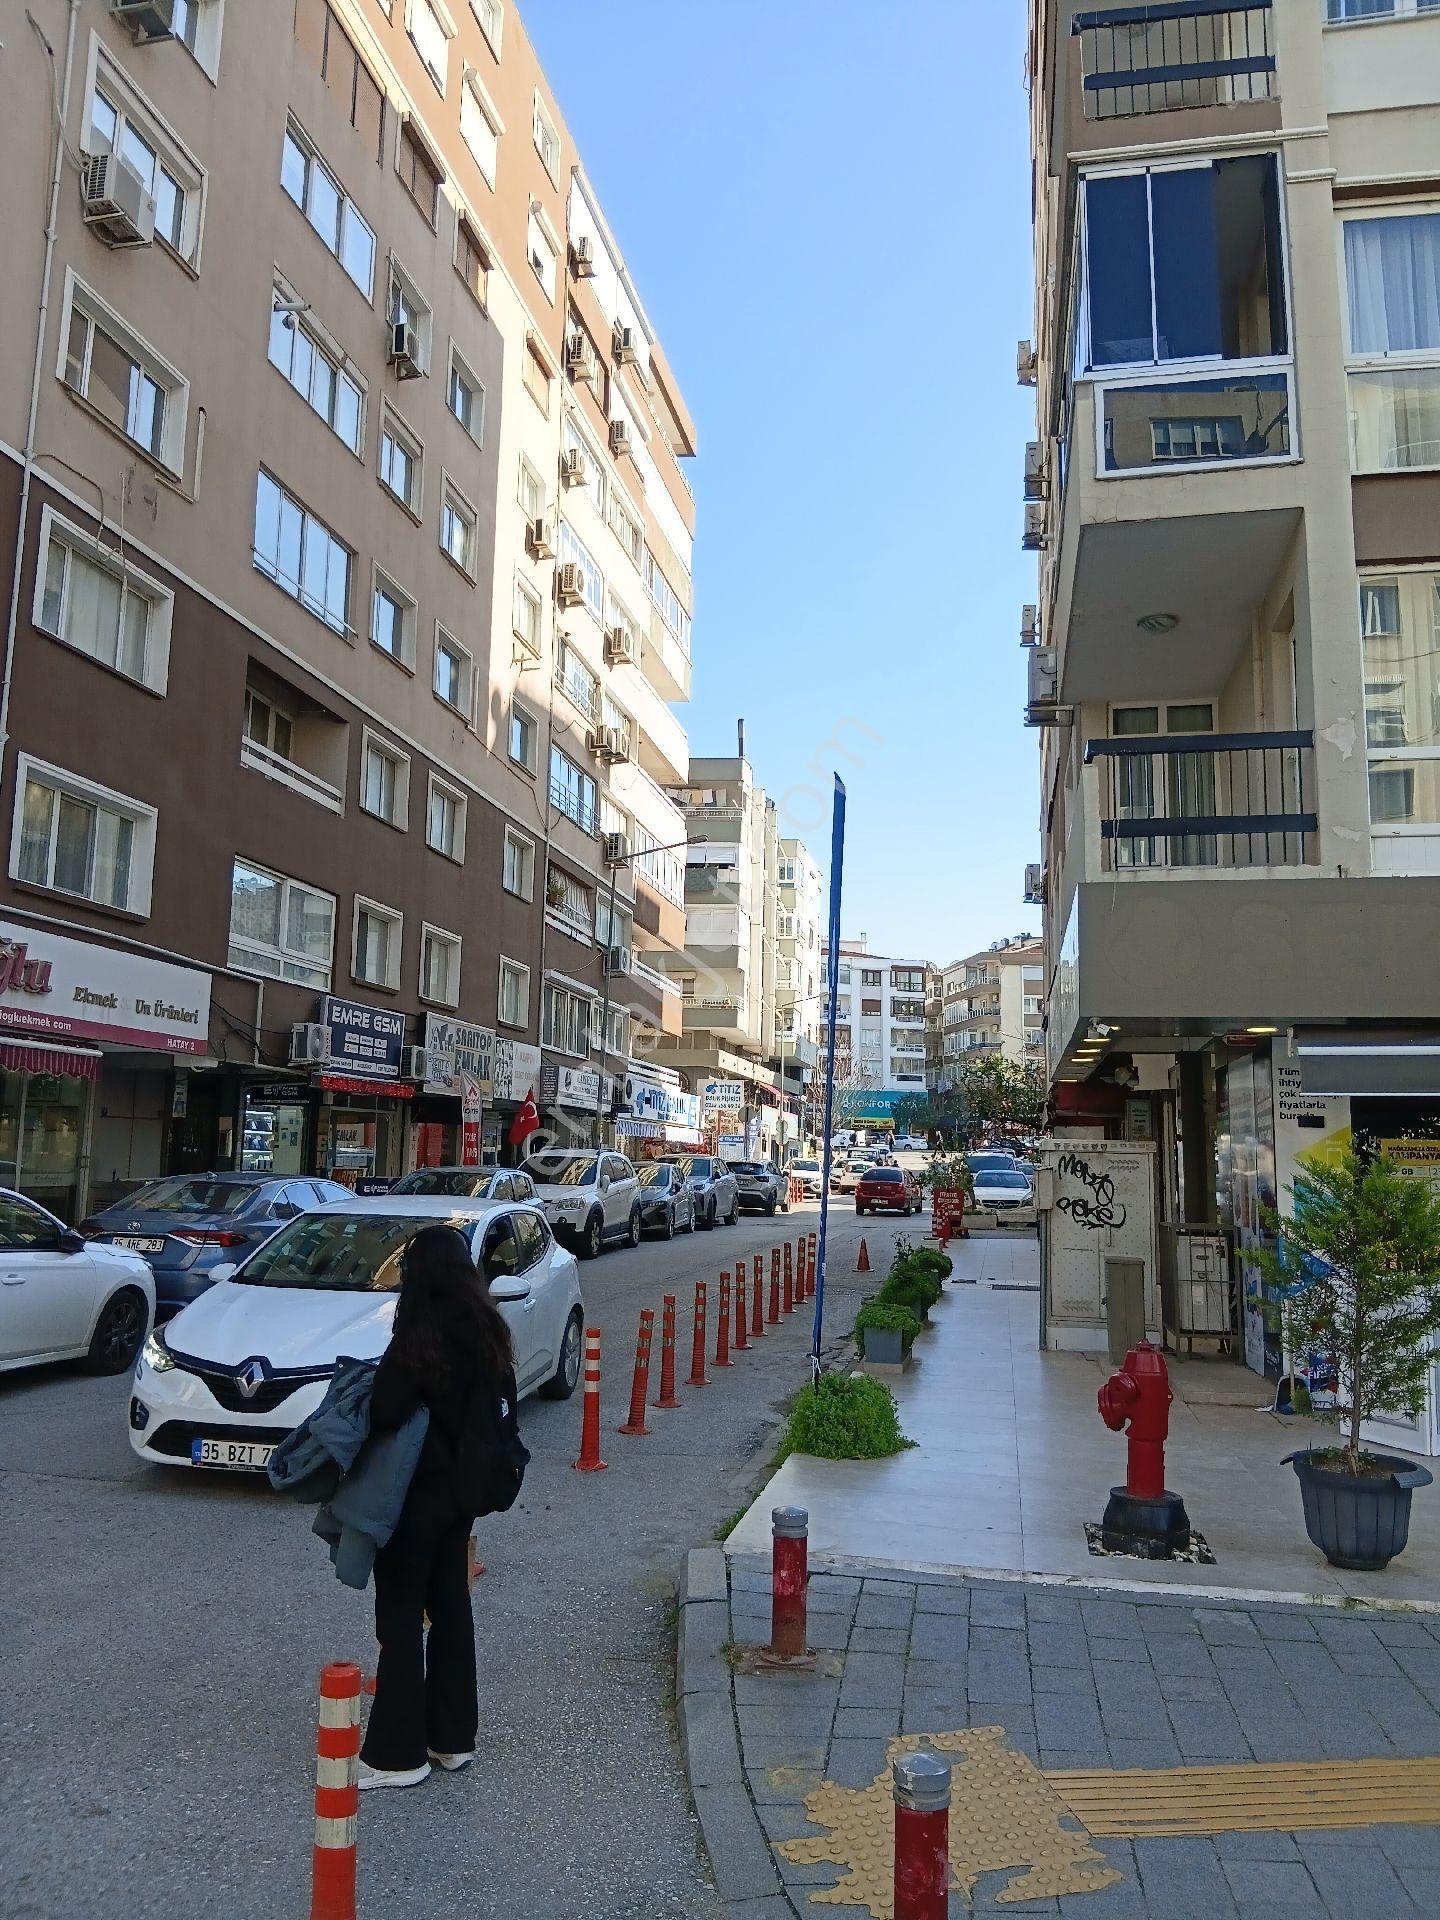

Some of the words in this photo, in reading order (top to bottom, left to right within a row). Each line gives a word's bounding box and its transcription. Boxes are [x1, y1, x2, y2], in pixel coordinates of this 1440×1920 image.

[73, 986, 118, 1009] Ekmek
[136, 999, 151, 1016] Un
[154, 1000, 199, 1025] Ürünleri
[332, 1006, 371, 1029] EMRE
[374, 1015, 401, 1035] GSM
[167, 1038, 189, 1050] HATAY
[190, 1041, 195, 1050] 2
[454, 1049, 491, 1081] EMLAK
[1278, 1067, 1300, 1076] Tüm
[1279, 1090, 1296, 1099] çok
[1279, 1100, 1326, 1110] fiyatlarla
[1401, 1168, 1413, 1176] GB
[202, 1442, 219, 1460] 35
[228, 1444, 256, 1463] BZT
